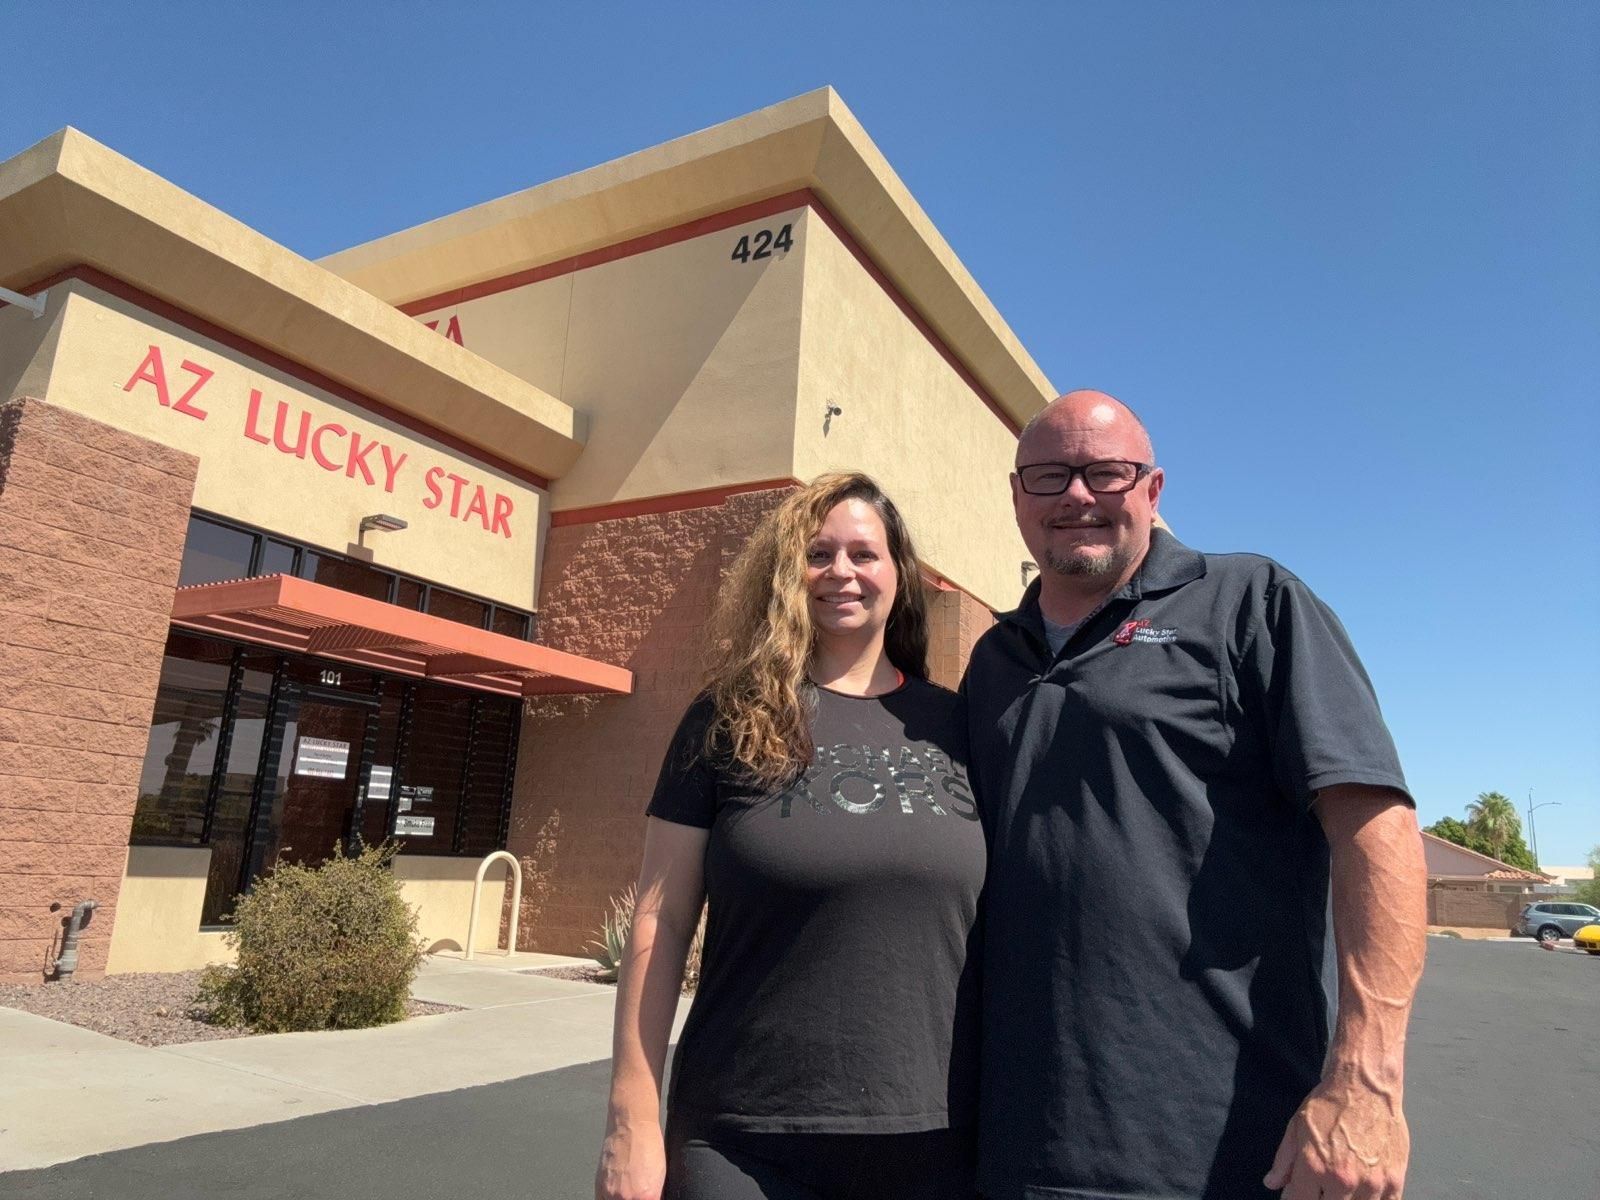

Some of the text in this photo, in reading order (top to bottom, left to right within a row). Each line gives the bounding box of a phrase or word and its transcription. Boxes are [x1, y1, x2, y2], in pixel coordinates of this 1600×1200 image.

[731, 223, 793, 264] 424
[123, 345, 514, 539] AZ LUCKY STAR
[1133, 633, 1177, 643] Automotive
[1135, 626, 1177, 637] Lucky Star
[320, 670, 341, 685] 101
[780, 768, 980, 821] KORS
